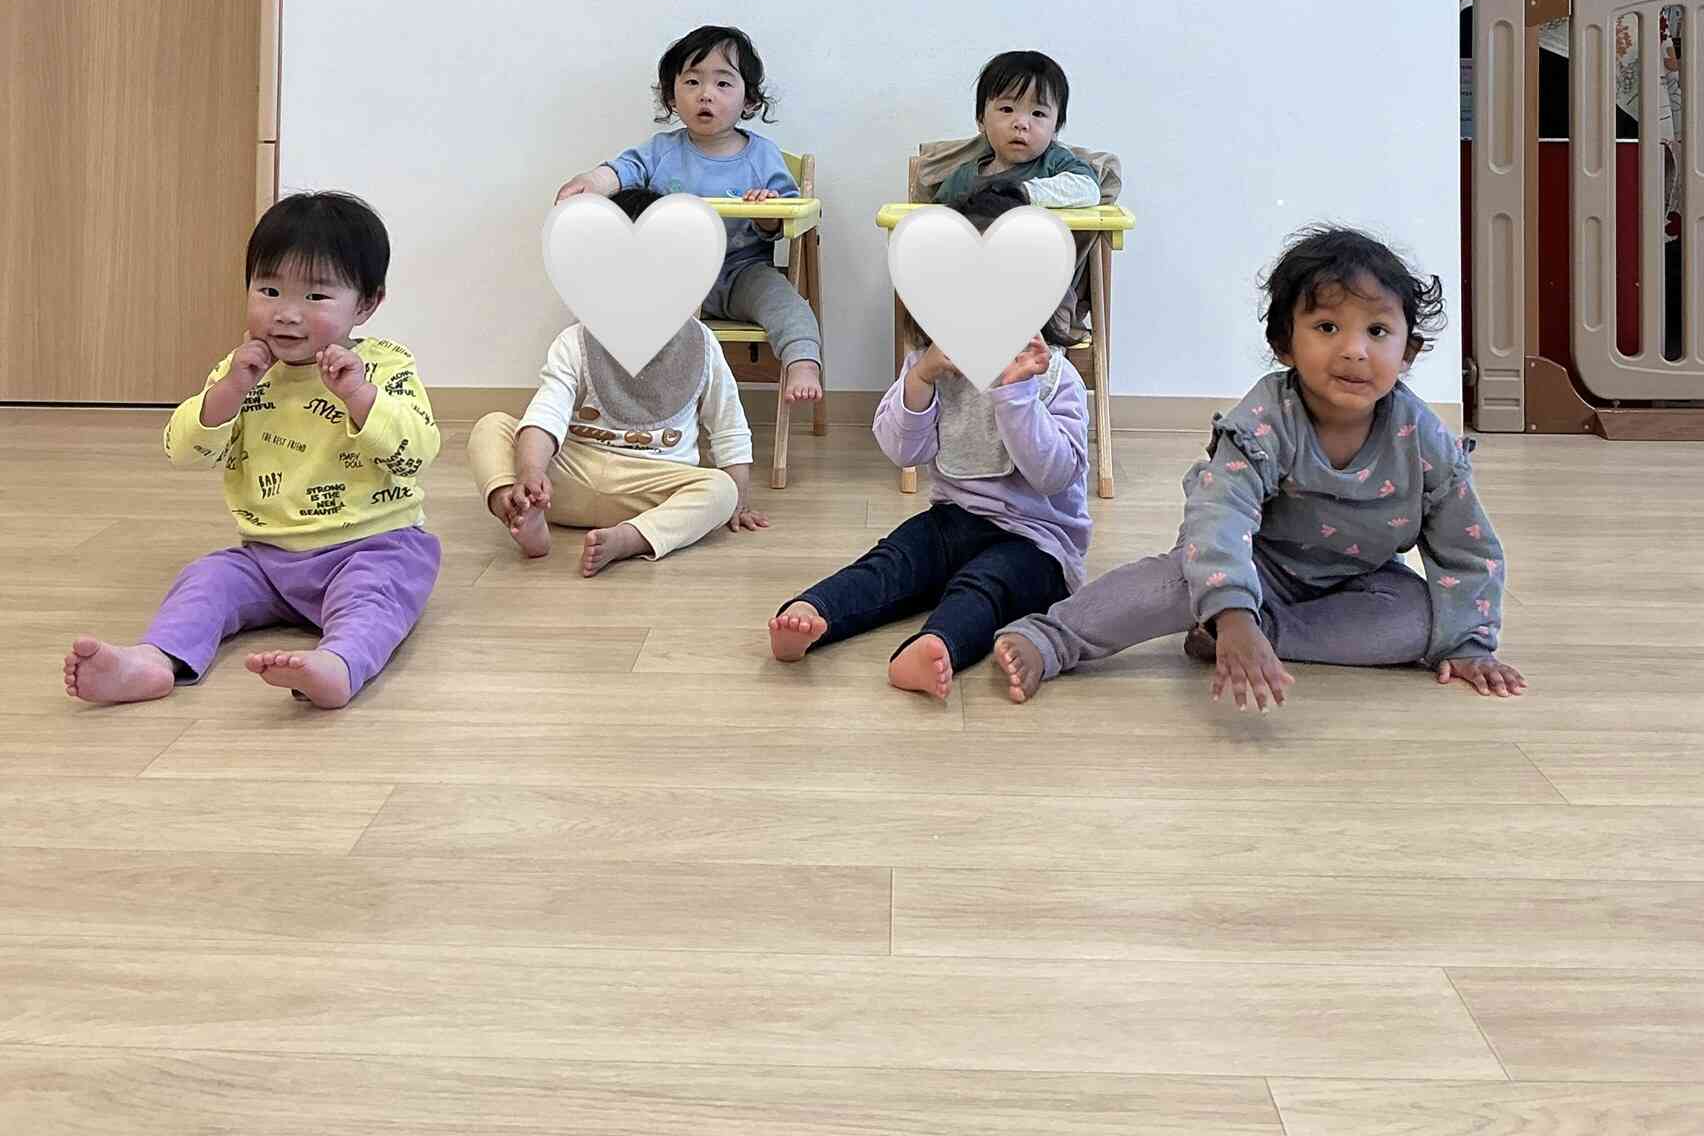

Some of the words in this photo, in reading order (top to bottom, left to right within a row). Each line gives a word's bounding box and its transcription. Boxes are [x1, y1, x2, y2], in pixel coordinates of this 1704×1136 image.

[303, 398, 345, 424] STYLE
[258, 472, 282, 488] BABY
[306, 483, 346, 496] STRONG
[311, 494, 320, 502] IS
[322, 491, 340, 500] THE
[371, 486, 413, 505] STYLE
